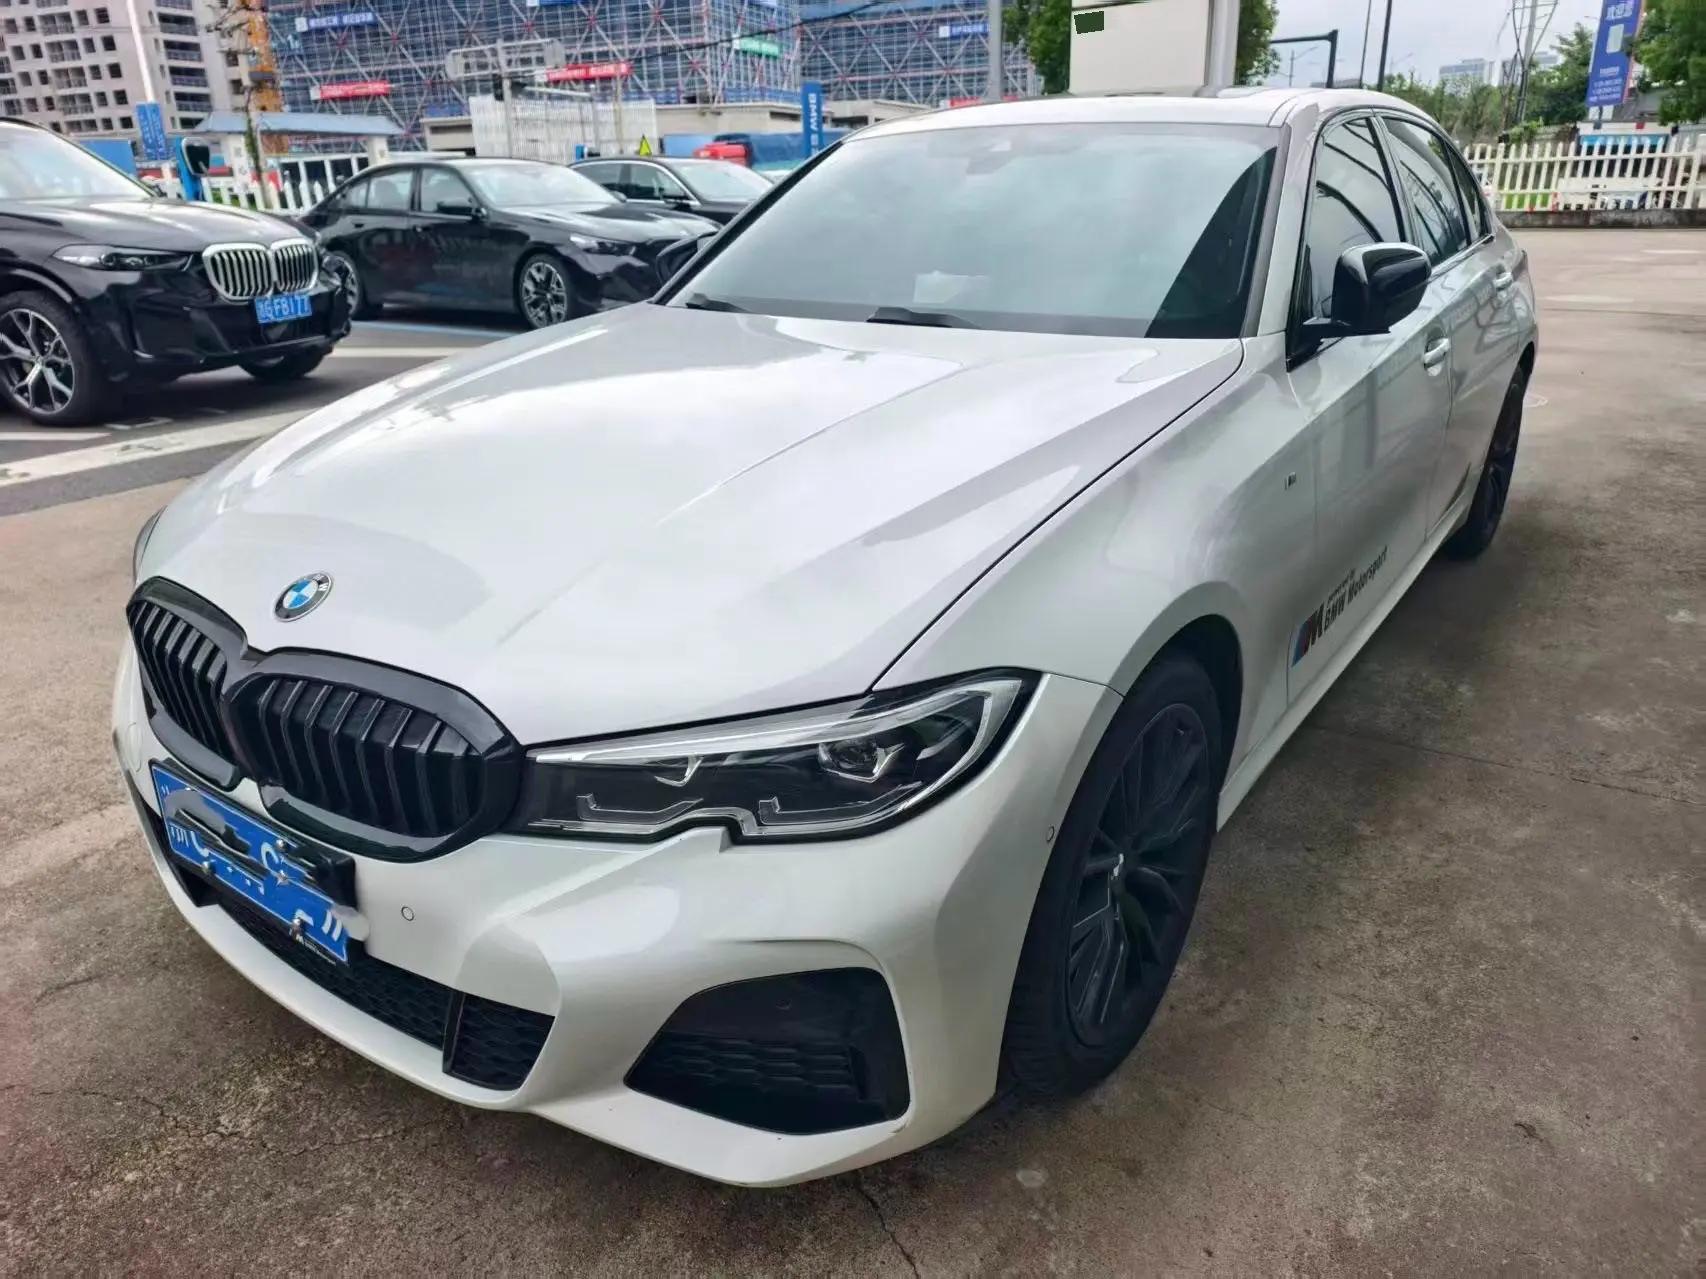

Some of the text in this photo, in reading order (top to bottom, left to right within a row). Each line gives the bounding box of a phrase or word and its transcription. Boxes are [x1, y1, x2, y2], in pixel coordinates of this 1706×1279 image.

[808, 93, 818, 131] BMW
[1324, 588, 1347, 632] BMW
[1347, 545, 1388, 606] Motorsport
